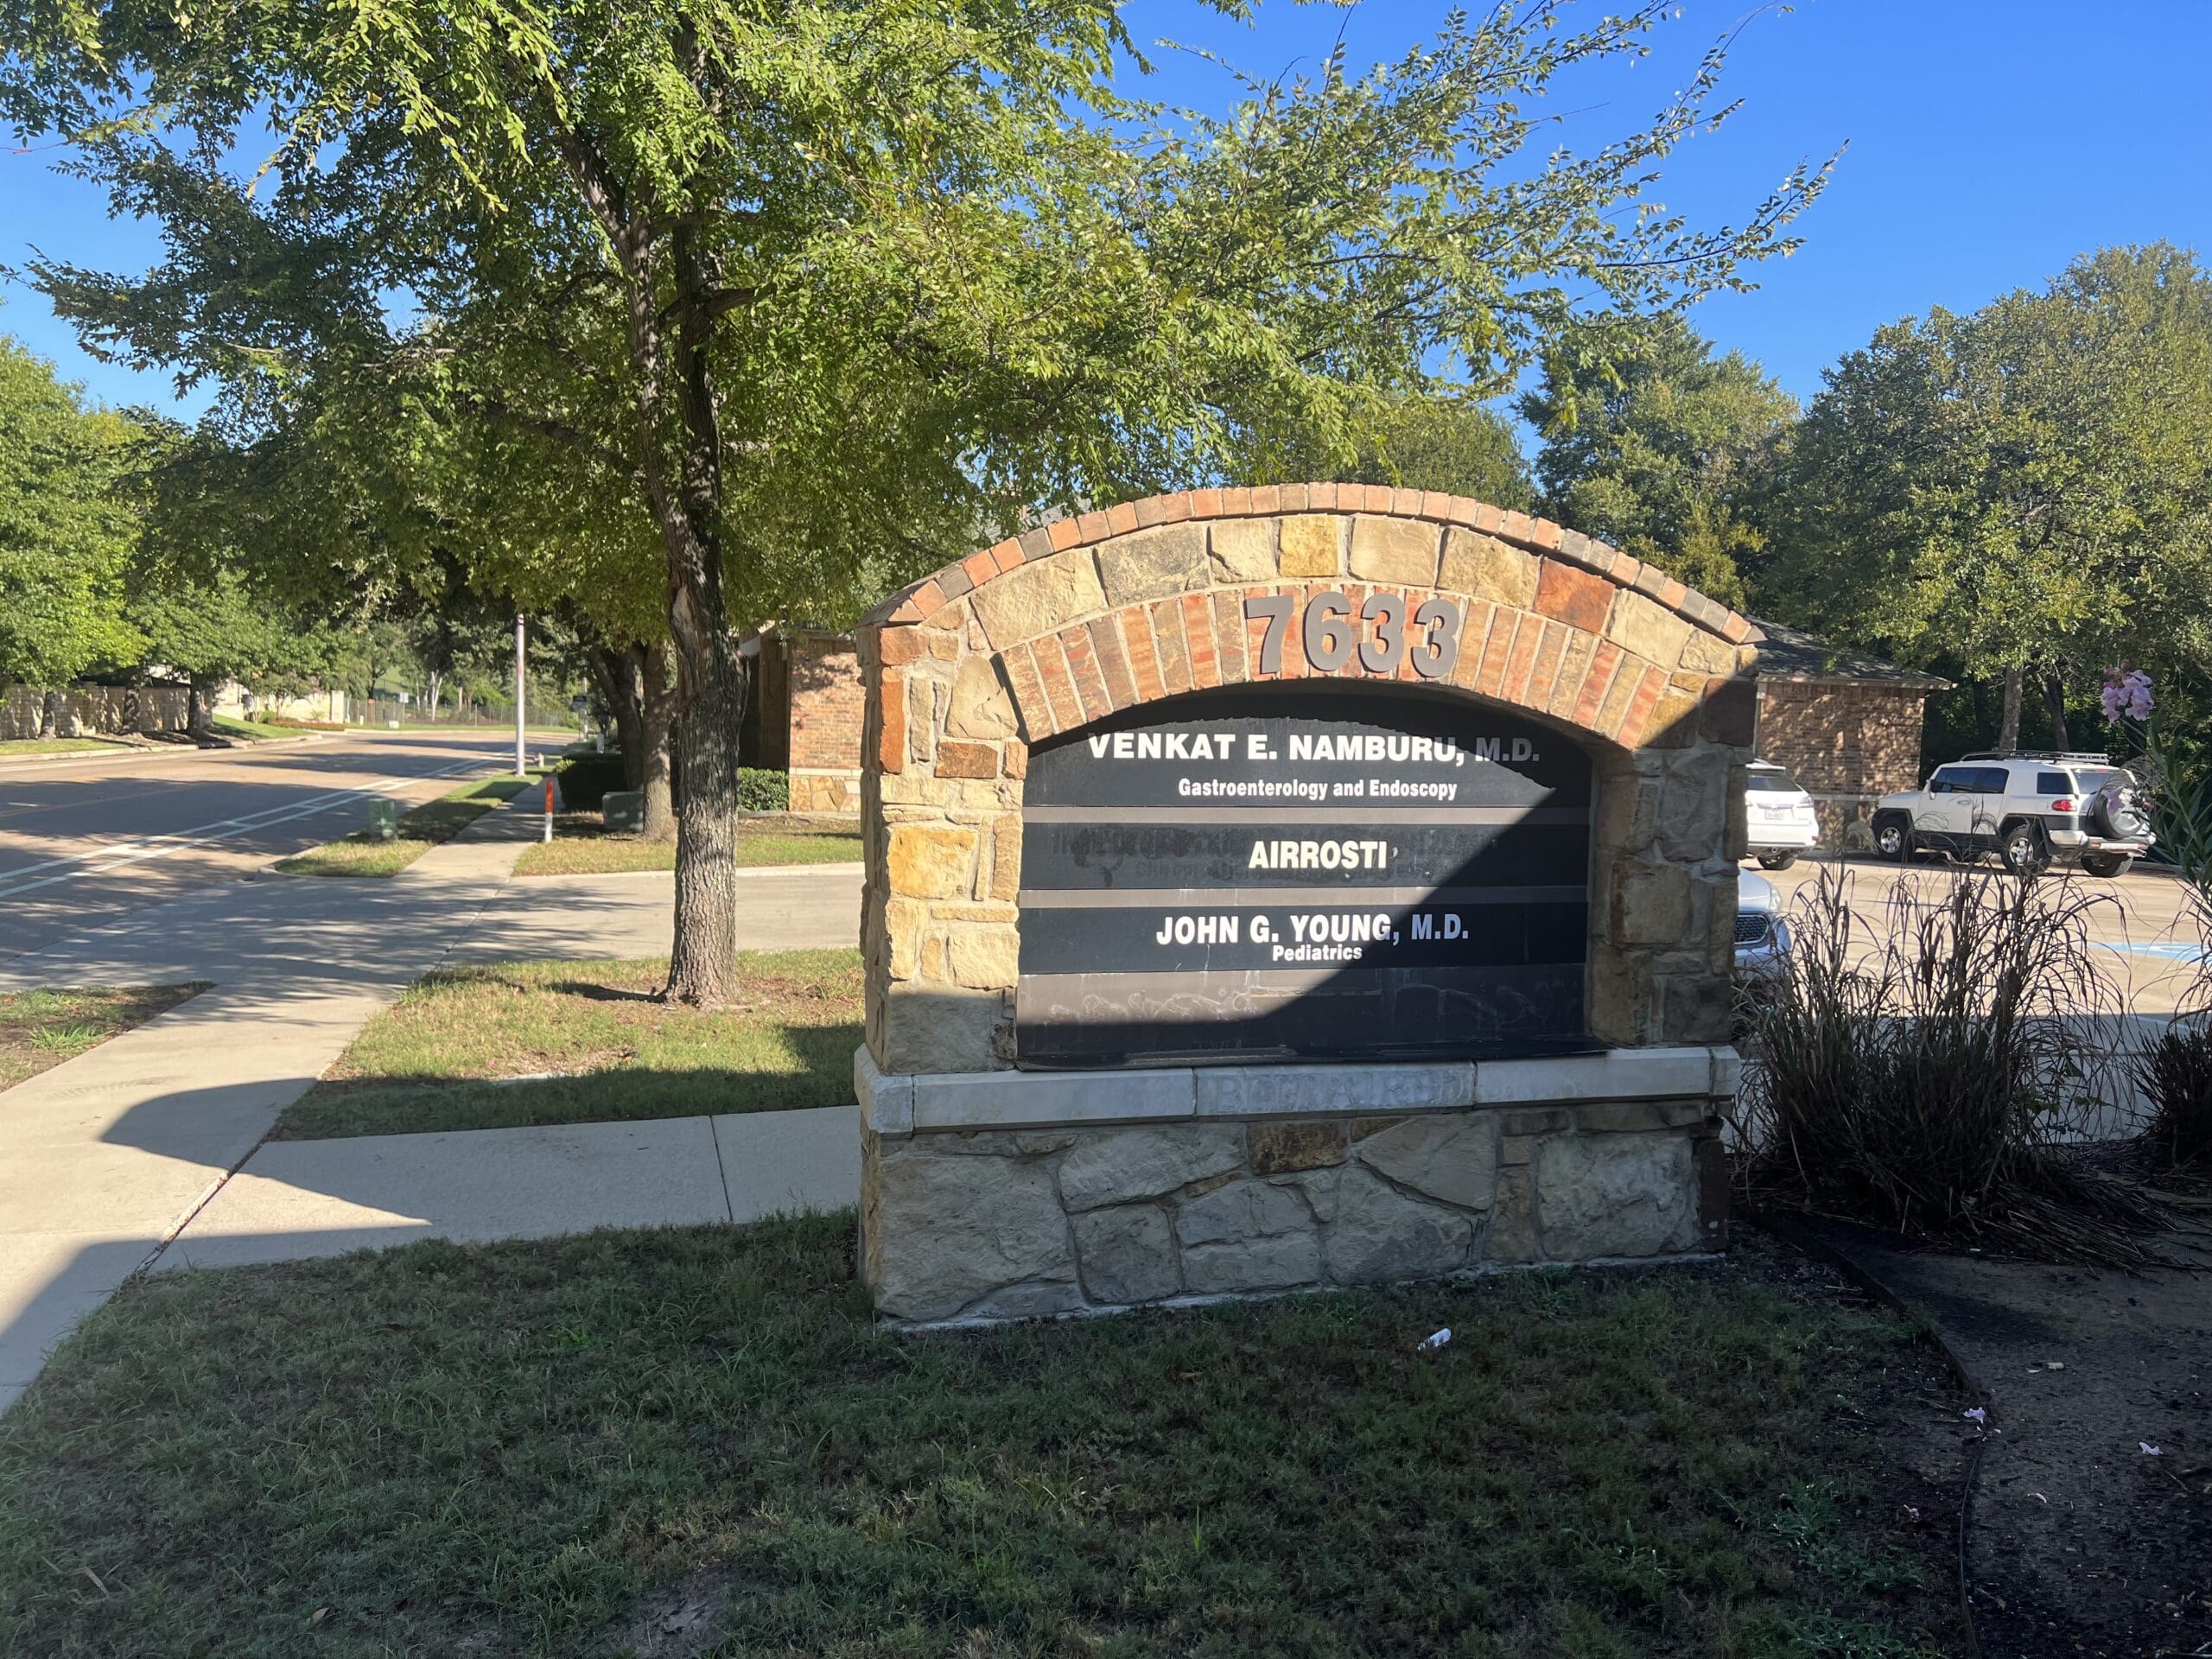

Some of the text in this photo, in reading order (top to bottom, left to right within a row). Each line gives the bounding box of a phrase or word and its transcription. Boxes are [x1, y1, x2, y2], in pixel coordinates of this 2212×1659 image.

[1243, 591, 1459, 677] 7633
[1088, 733, 1541, 767] VENKAT E. NAMBURU, M.D.
[1178, 778, 1458, 800] Gastroenterology and Endoscopy
[1248, 840, 1388, 869] AIRROSTI
[1156, 913, 1469, 946] JOHN G. YOUNG, M.D.
[1272, 944, 1363, 961] Pediatrics
